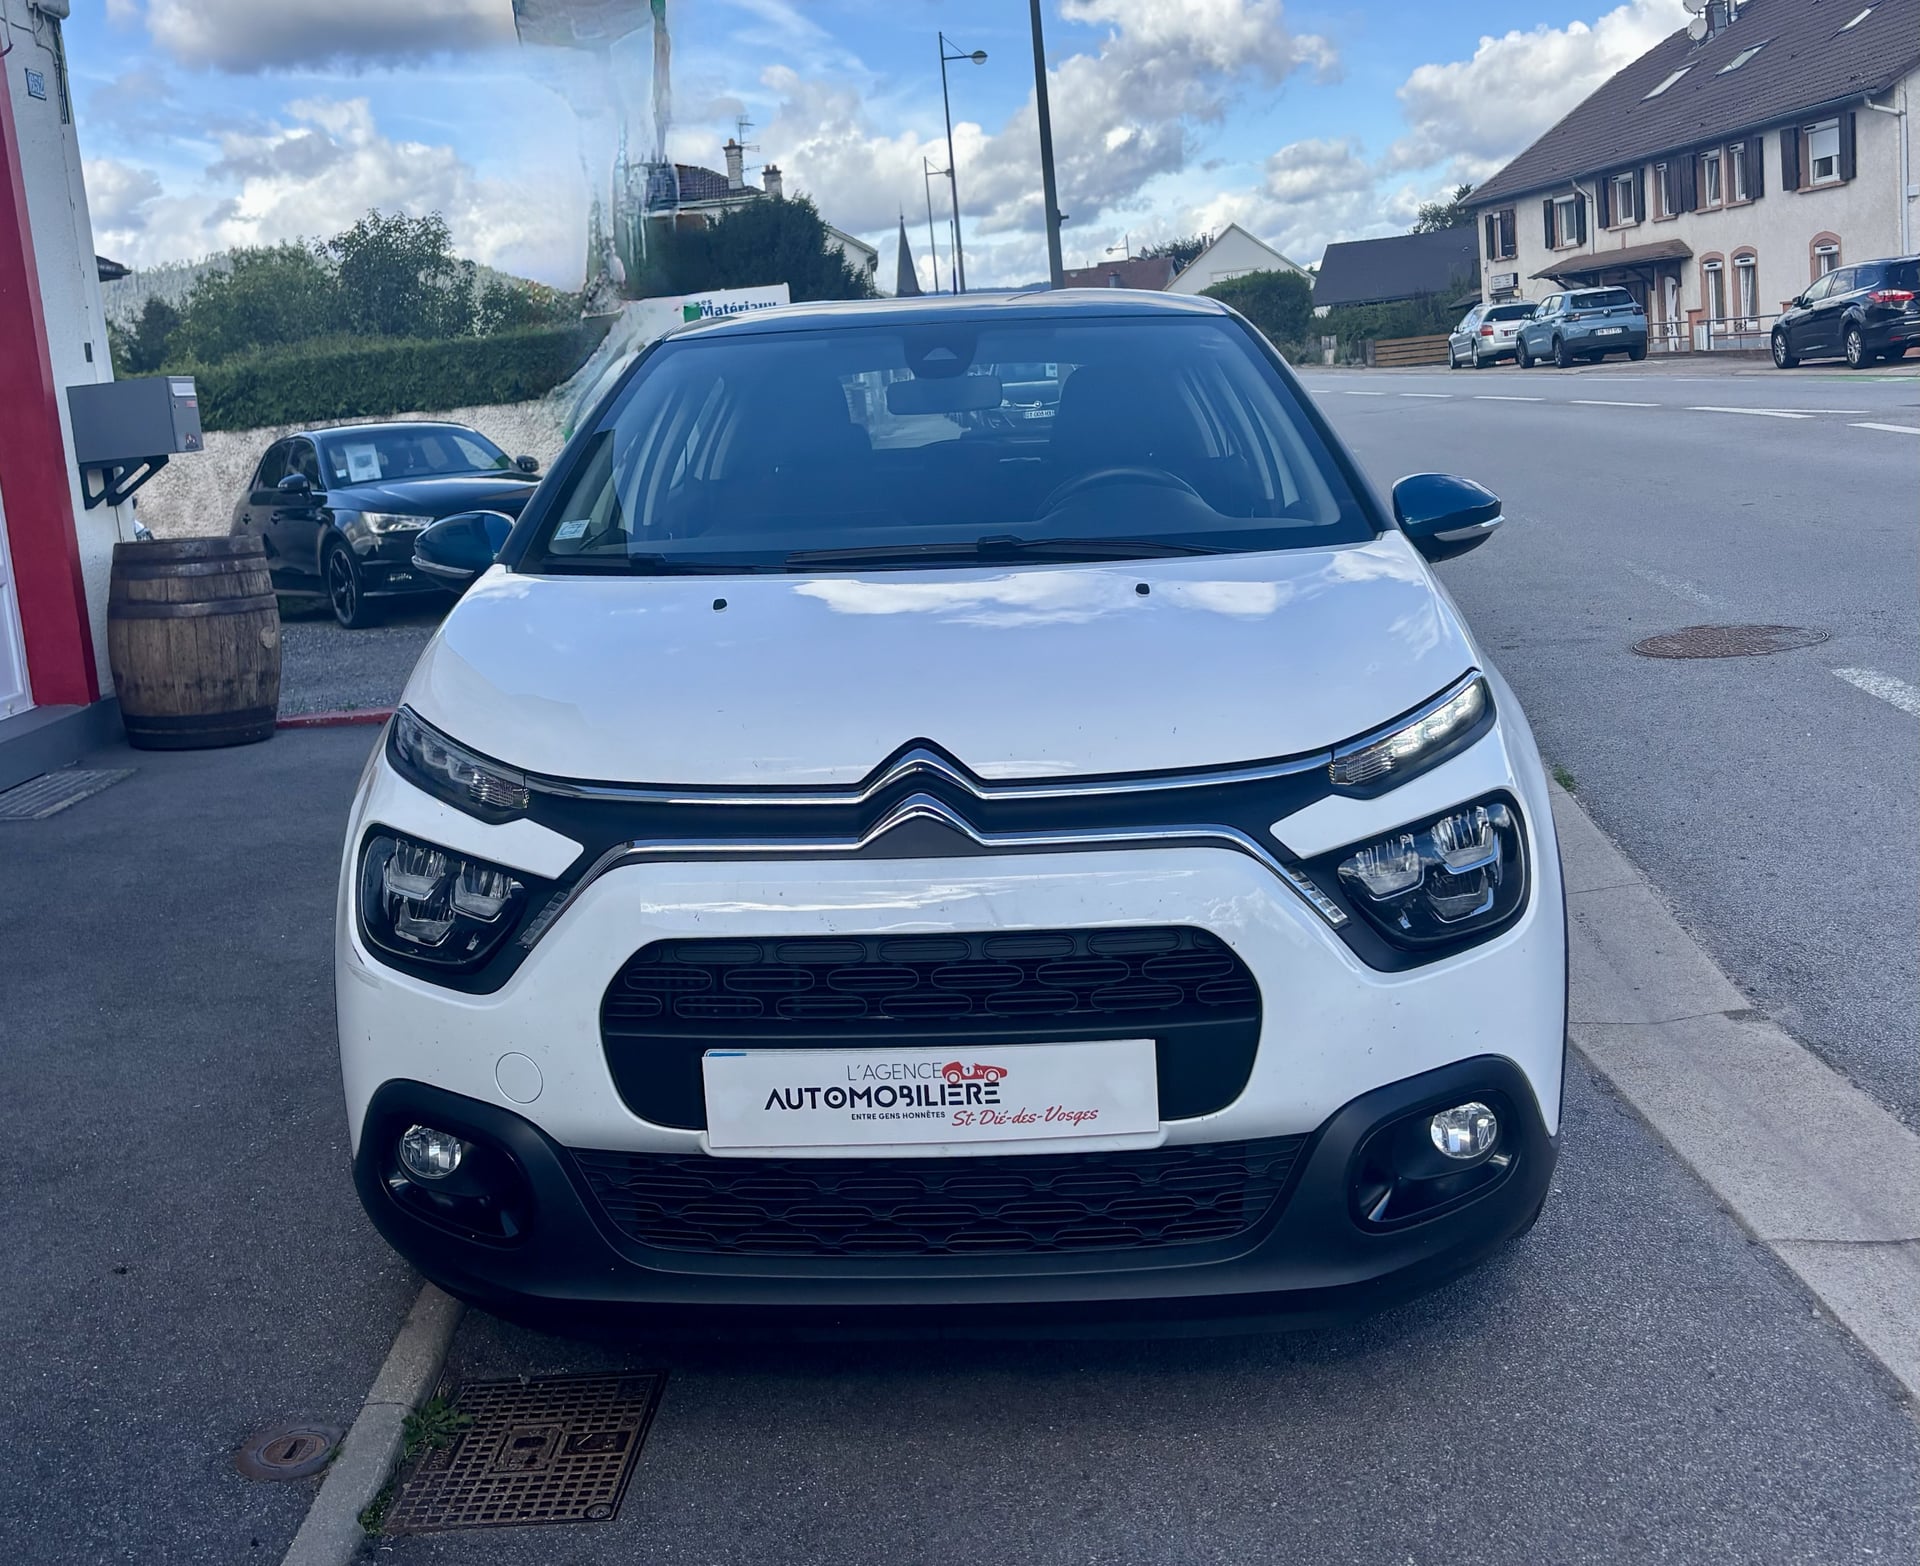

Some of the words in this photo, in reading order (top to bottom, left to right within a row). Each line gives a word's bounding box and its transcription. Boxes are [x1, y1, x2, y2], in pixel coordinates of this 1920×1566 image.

[847, 1062, 943, 1081] L'AGENCE
[851, 1113, 877, 1121] ENTRE
[878, 1112, 901, 1120] GENS
[902, 1110, 946, 1120] HONNÊTES
[951, 1105, 1099, 1127] St-Dié-des-Vosges
